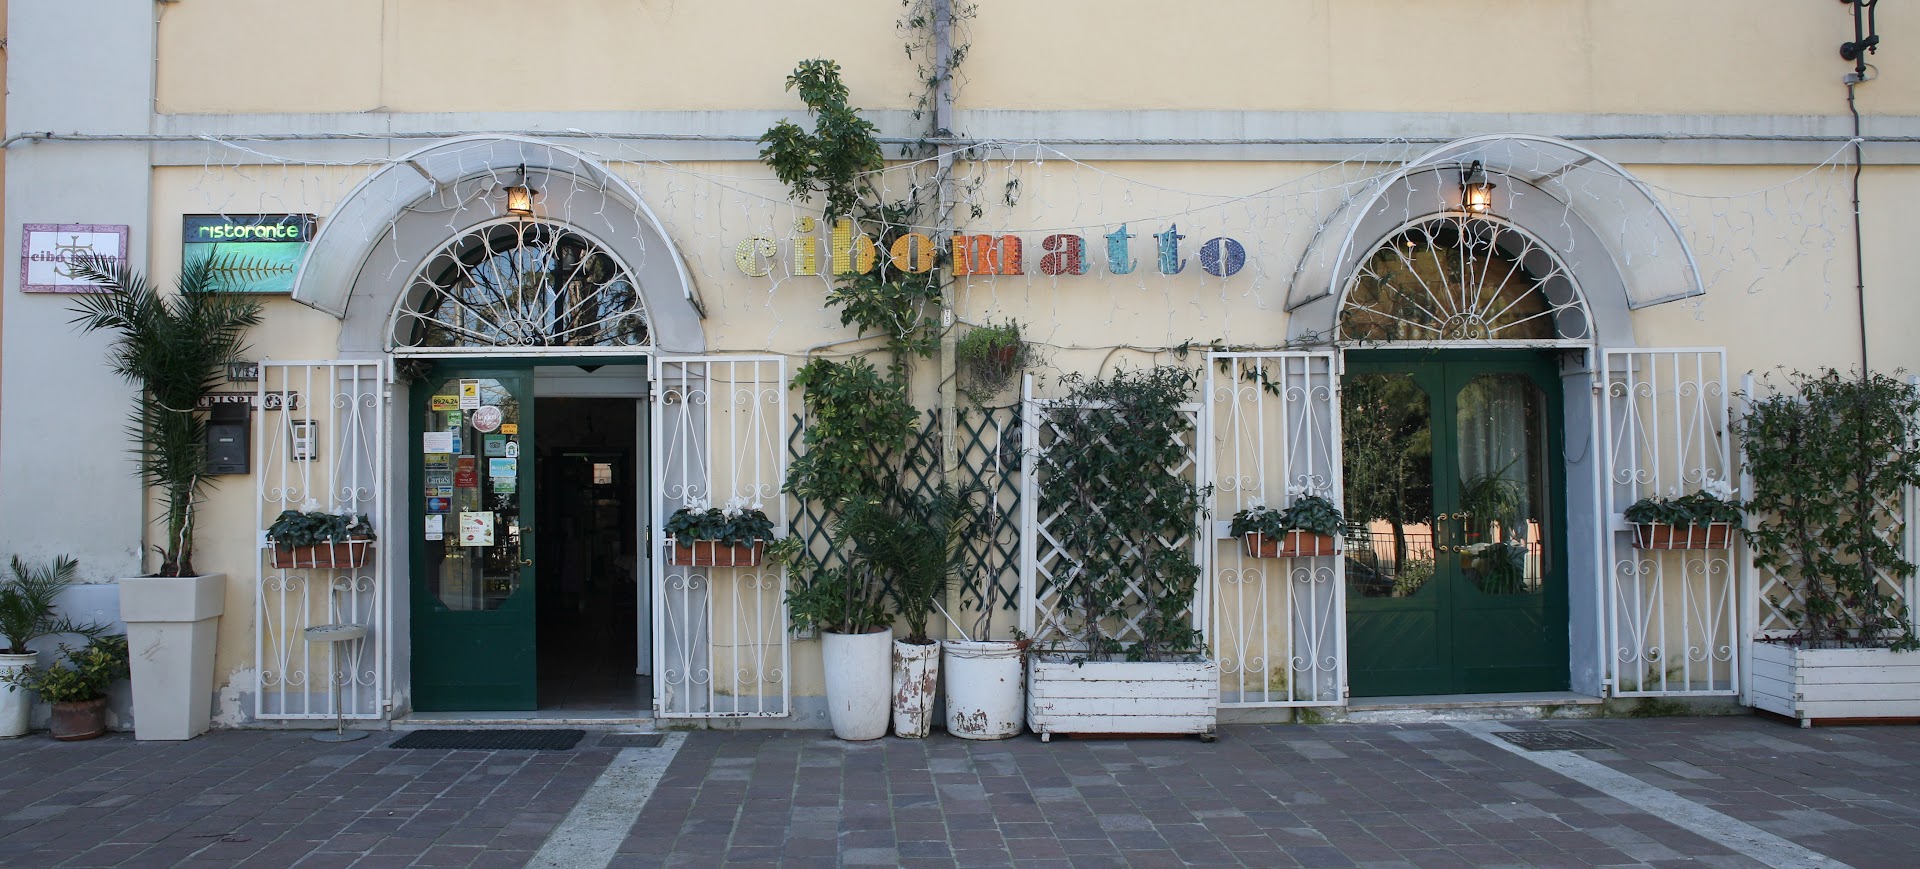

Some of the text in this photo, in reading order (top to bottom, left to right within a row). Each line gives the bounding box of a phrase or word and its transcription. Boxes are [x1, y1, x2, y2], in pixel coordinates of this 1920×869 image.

[199, 223, 299, 238] ristorante
[30, 250, 65, 262] cibo
[427, 476, 450, 484] CartaSi
